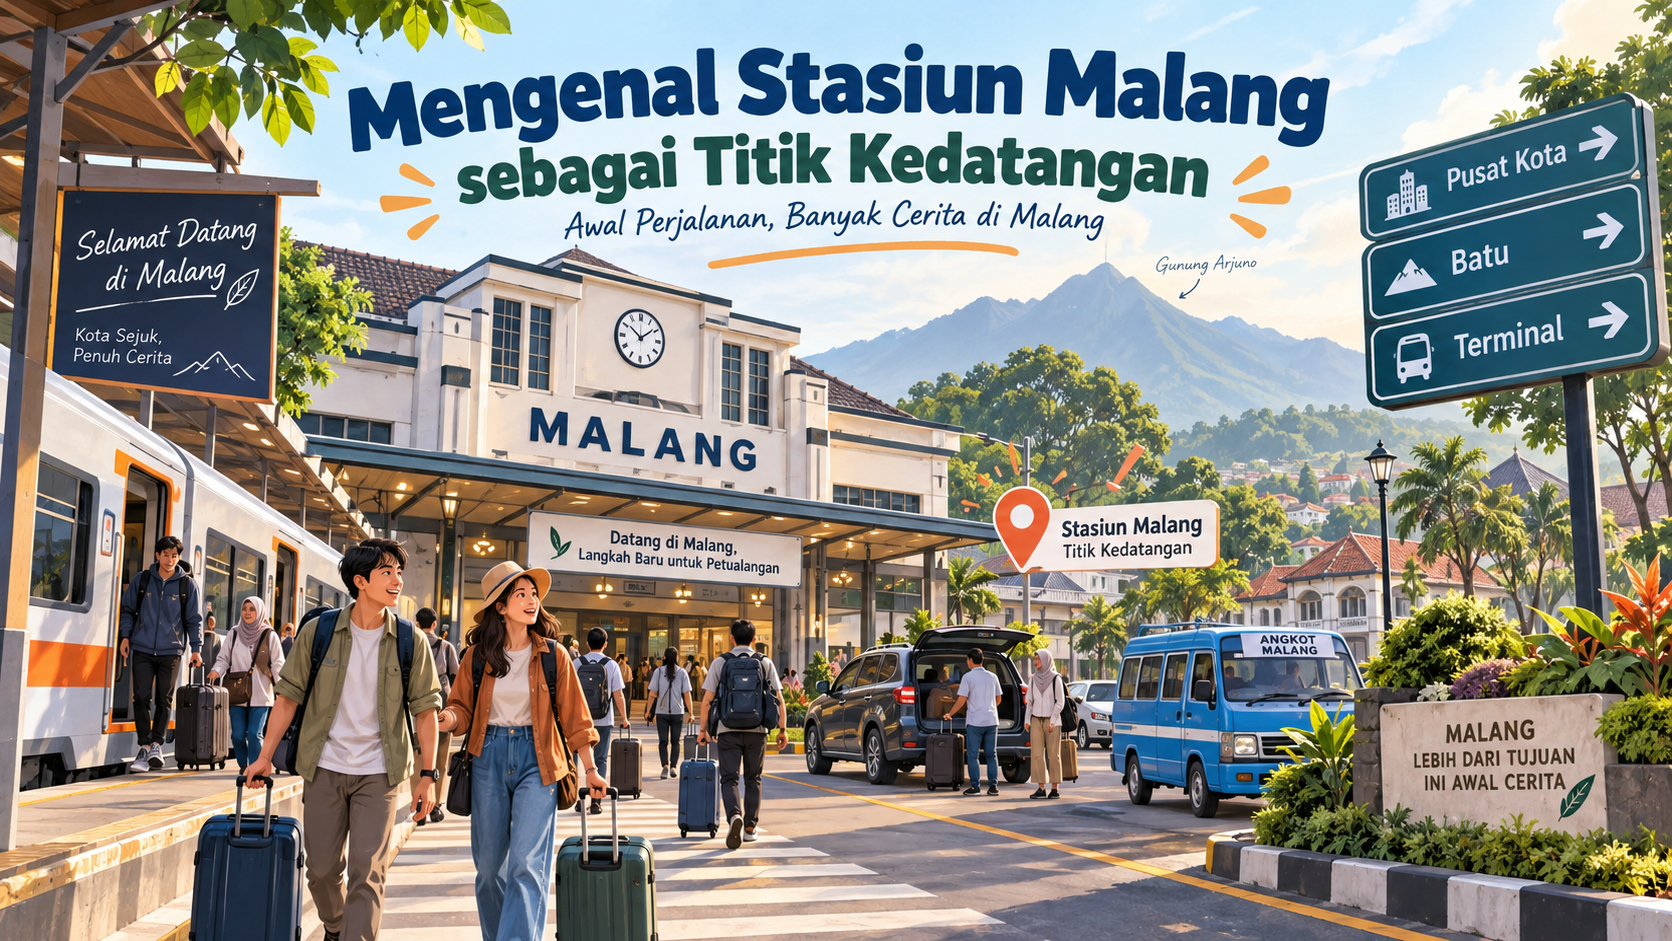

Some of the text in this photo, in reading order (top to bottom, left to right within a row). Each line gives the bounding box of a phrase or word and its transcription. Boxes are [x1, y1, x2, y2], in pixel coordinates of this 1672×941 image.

[1447, 144, 1566, 191] Pusat Kota
[76, 218, 257, 260] Selamat Datang
[1451, 244, 1509, 275] Batu
[105, 257, 226, 291] di Malang
[75, 328, 162, 345] Kota Sejuk,
[1454, 314, 1564, 359] Terminal
[73, 348, 172, 364] Penuh Cerita
[530, 407, 757, 472] MALANG
[1061, 514, 1202, 538] Stasiun Malang
[610, 530, 737, 556] Datang di Malang,
[1063, 541, 1192, 558] Titik Kedatangan
[578, 548, 780, 576] Langkah Baru untuk Petualangan
[1260, 634, 1316, 645] ANGKOT
[1262, 645, 1318, 655] MALANG
[1446, 719, 1535, 743] MALANG
[1414, 748, 1575, 768] LEBIH DARI TUJUAN
[1424, 773, 1566, 791] INI AWAL CERITA
